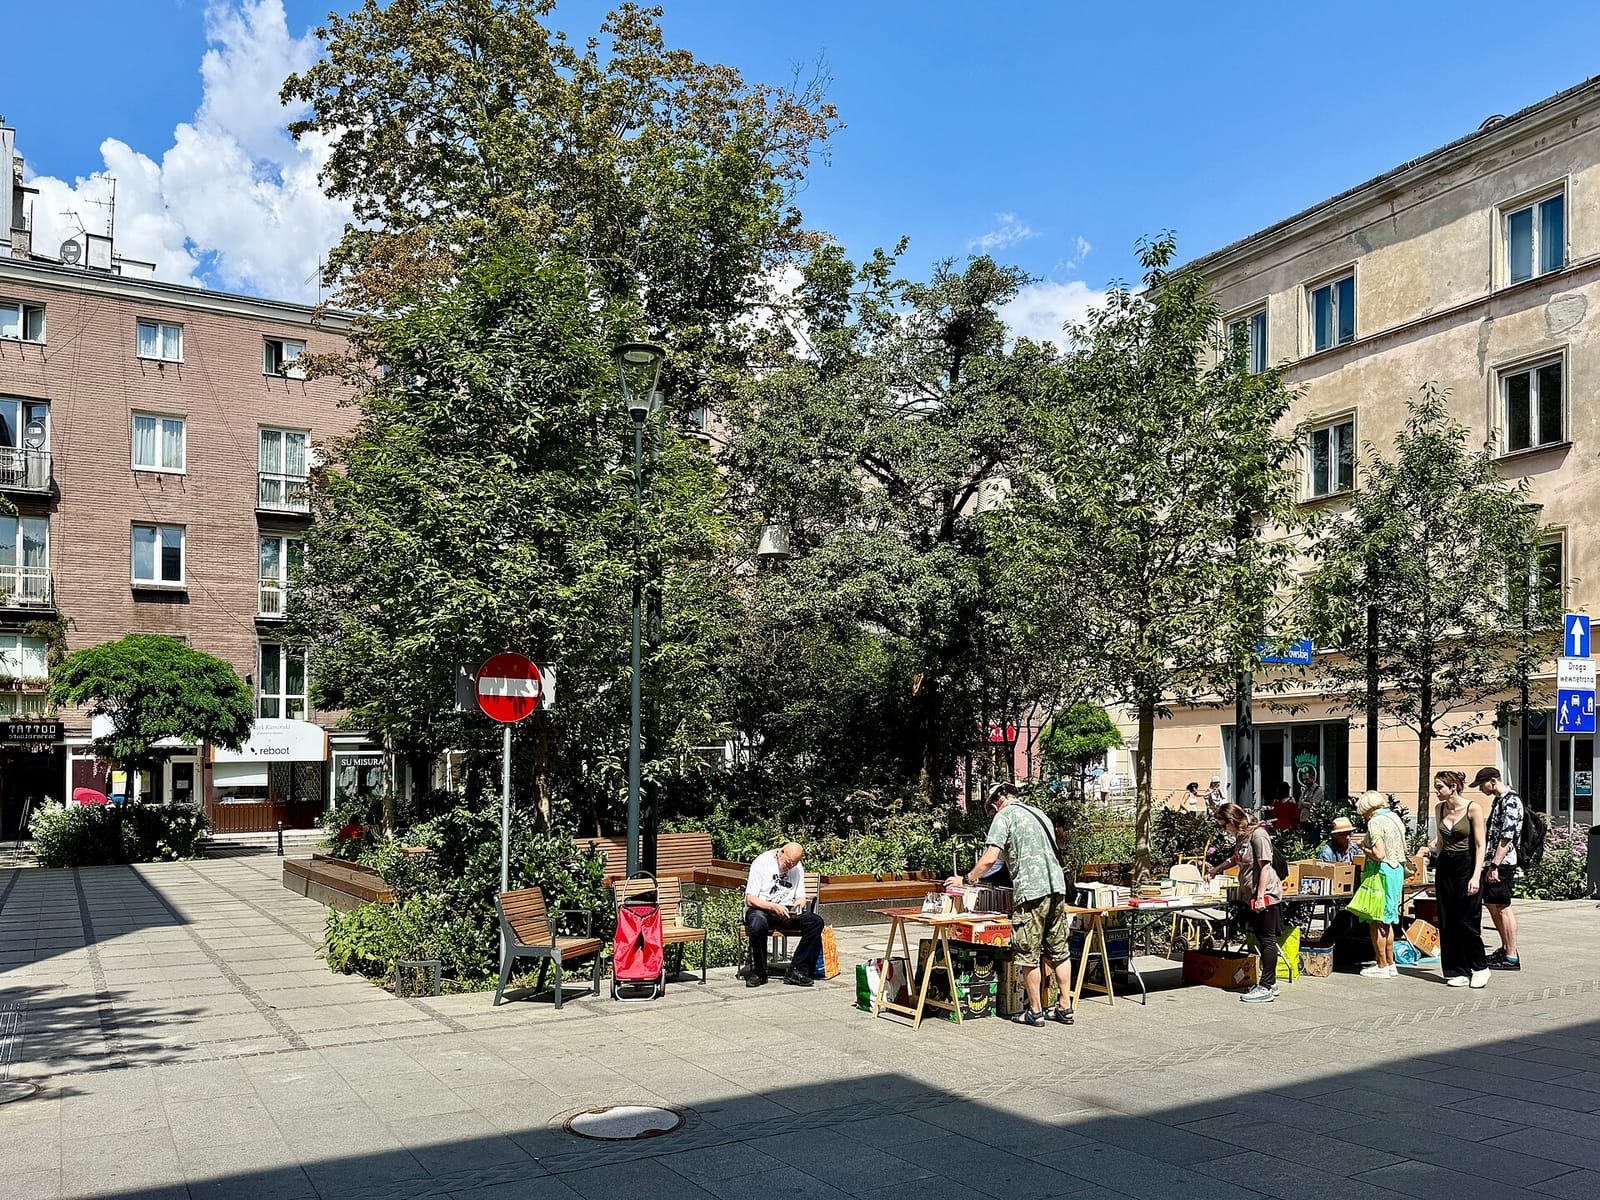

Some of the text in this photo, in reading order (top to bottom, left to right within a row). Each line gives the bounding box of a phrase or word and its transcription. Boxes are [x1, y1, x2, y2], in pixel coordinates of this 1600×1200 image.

[1568, 662, 1587, 673] Droga
[8, 724, 56, 734] TATTOO
[259, 746, 290, 756] reboot
[341, 758, 385, 766] SU MISURA
